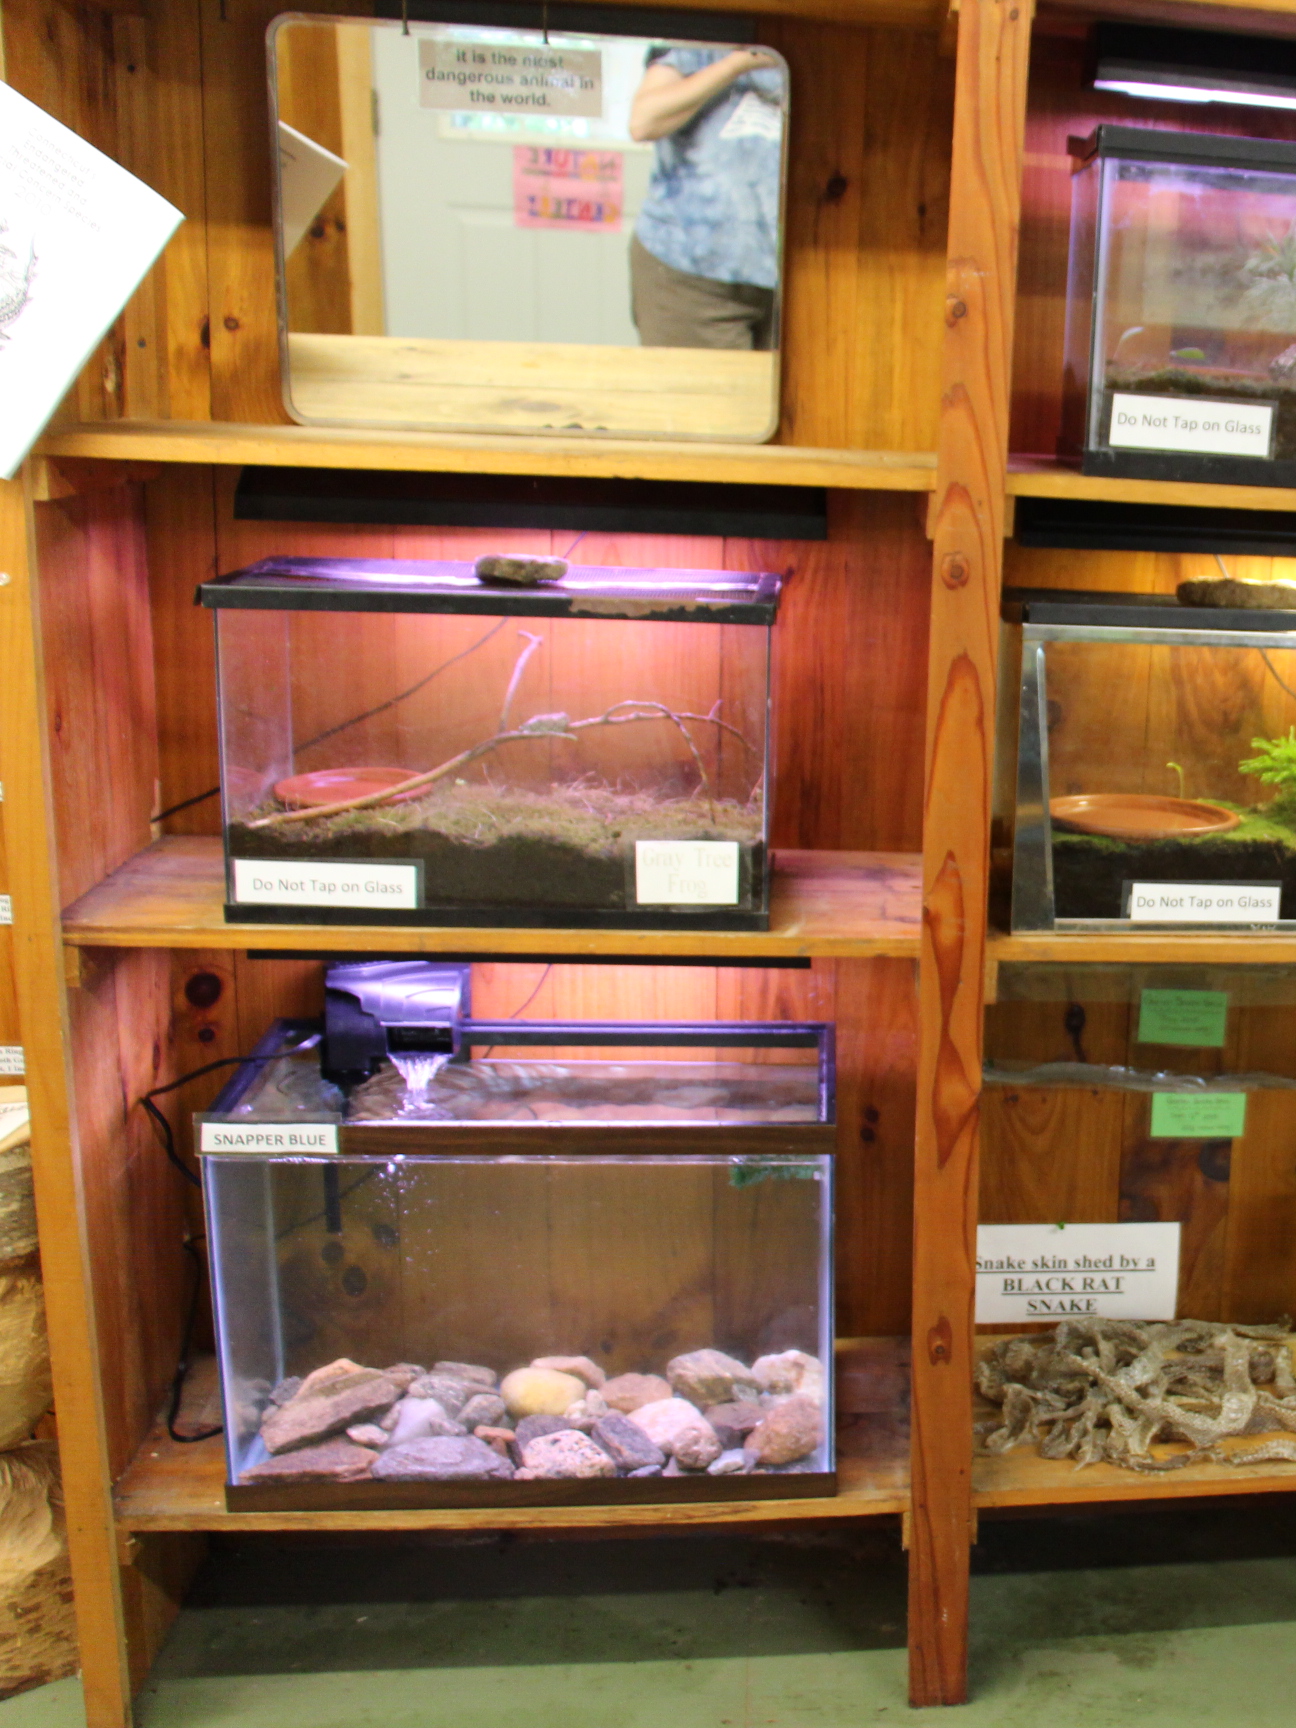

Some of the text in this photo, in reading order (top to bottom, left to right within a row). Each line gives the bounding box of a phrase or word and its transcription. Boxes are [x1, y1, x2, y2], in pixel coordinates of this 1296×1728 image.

[472, 50, 486, 64] is
[492, 51, 517, 66] the
[522, 54, 564, 69] most
[425, 67, 594, 89] dangerous animal in
[470, 89, 550, 106] the world.
[1117, 412, 1262, 435] Do Not Tap on Glass
[642, 847, 732, 871] Gray Tree
[252, 878, 403, 895] Do Not Tap on Glass
[668, 873, 708, 899] Frog
[1136, 896, 1273, 910] Do Not Tap on Glass
[213, 1133, 326, 1146] SNAPPER BLUE
[976, 1254, 1156, 1272] Snake skin shed by a
[1002, 1276, 1125, 1293] BLACK RAT
[1026, 1299, 1098, 1313] SNAKE
